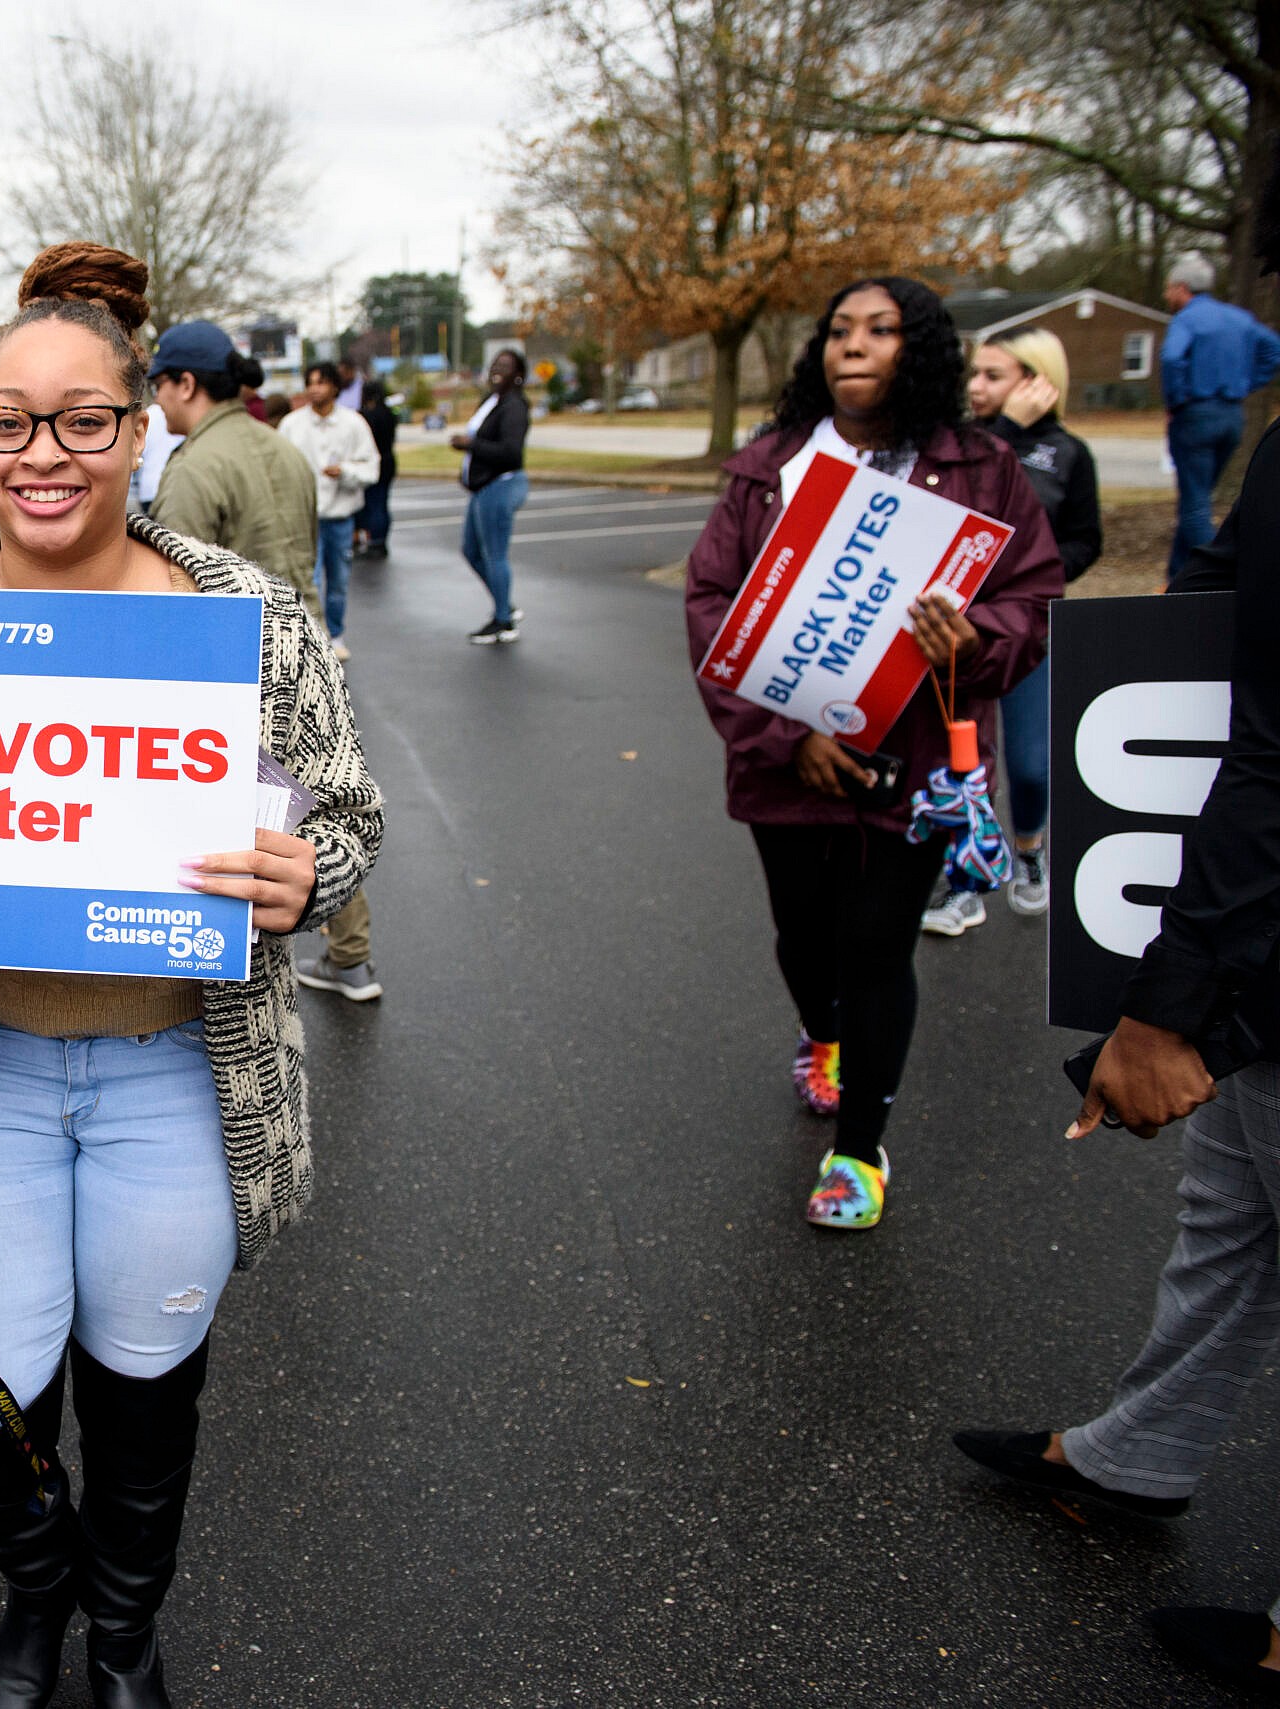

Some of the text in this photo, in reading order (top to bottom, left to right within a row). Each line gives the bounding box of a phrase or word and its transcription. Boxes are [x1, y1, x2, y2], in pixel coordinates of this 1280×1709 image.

[763, 492, 901, 705] BLACK VOTES
[818, 567, 898, 676] Matter
[87, 901, 202, 926] Common
[86, 922, 167, 945] Cause
[167, 960, 222, 971] more years
